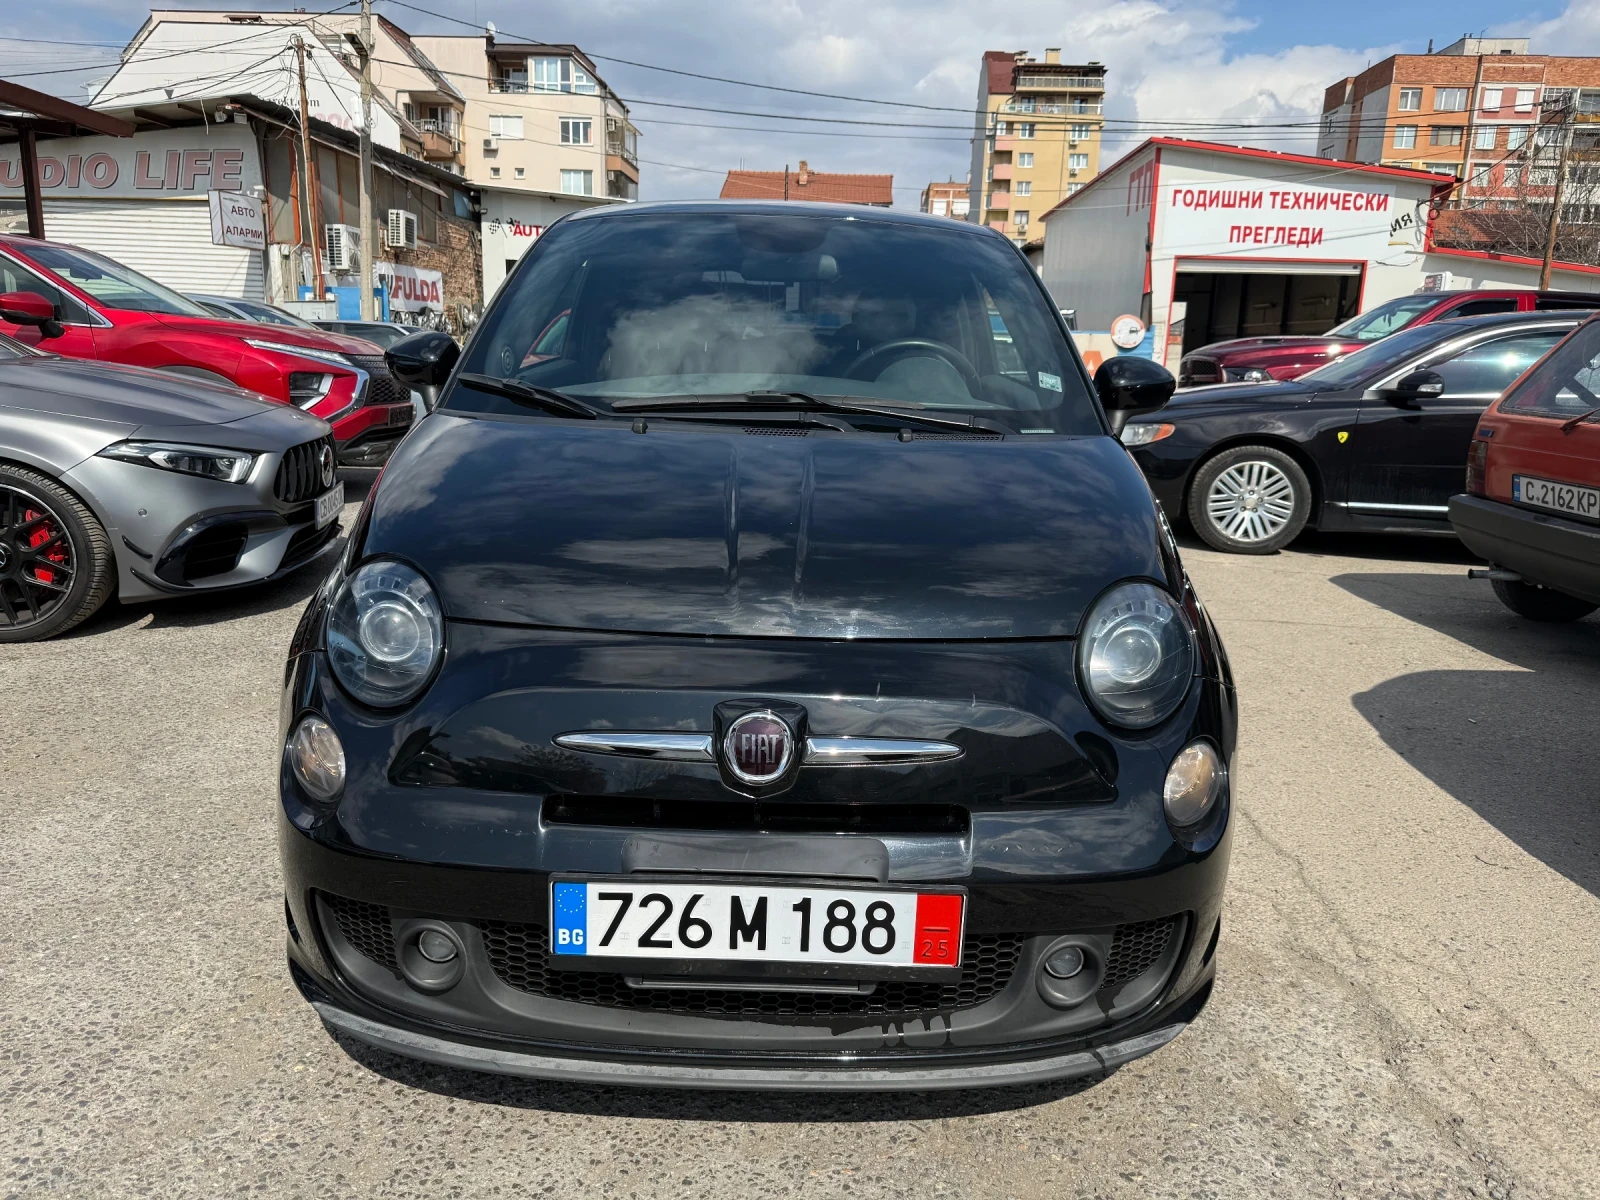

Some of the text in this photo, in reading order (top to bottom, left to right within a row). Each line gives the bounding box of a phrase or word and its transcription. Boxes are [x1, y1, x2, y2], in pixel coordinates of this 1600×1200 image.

[133, 149, 243, 190] LIFE
[231, 205, 255, 218] АВТО
[1172, 189, 1389, 212] ГОДИШНИ ТЕХНИЧЕСКИ
[226, 225, 263, 239] АЛАРМИ
[1229, 225, 1324, 248] ПРЕГЛЕДИ
[391, 275, 440, 303] FULDA
[741, 733, 780, 764] FIAT
[598, 892, 896, 955] 726 M 188
[558, 928, 584, 945] BG
[922, 940, 949, 958] 25
